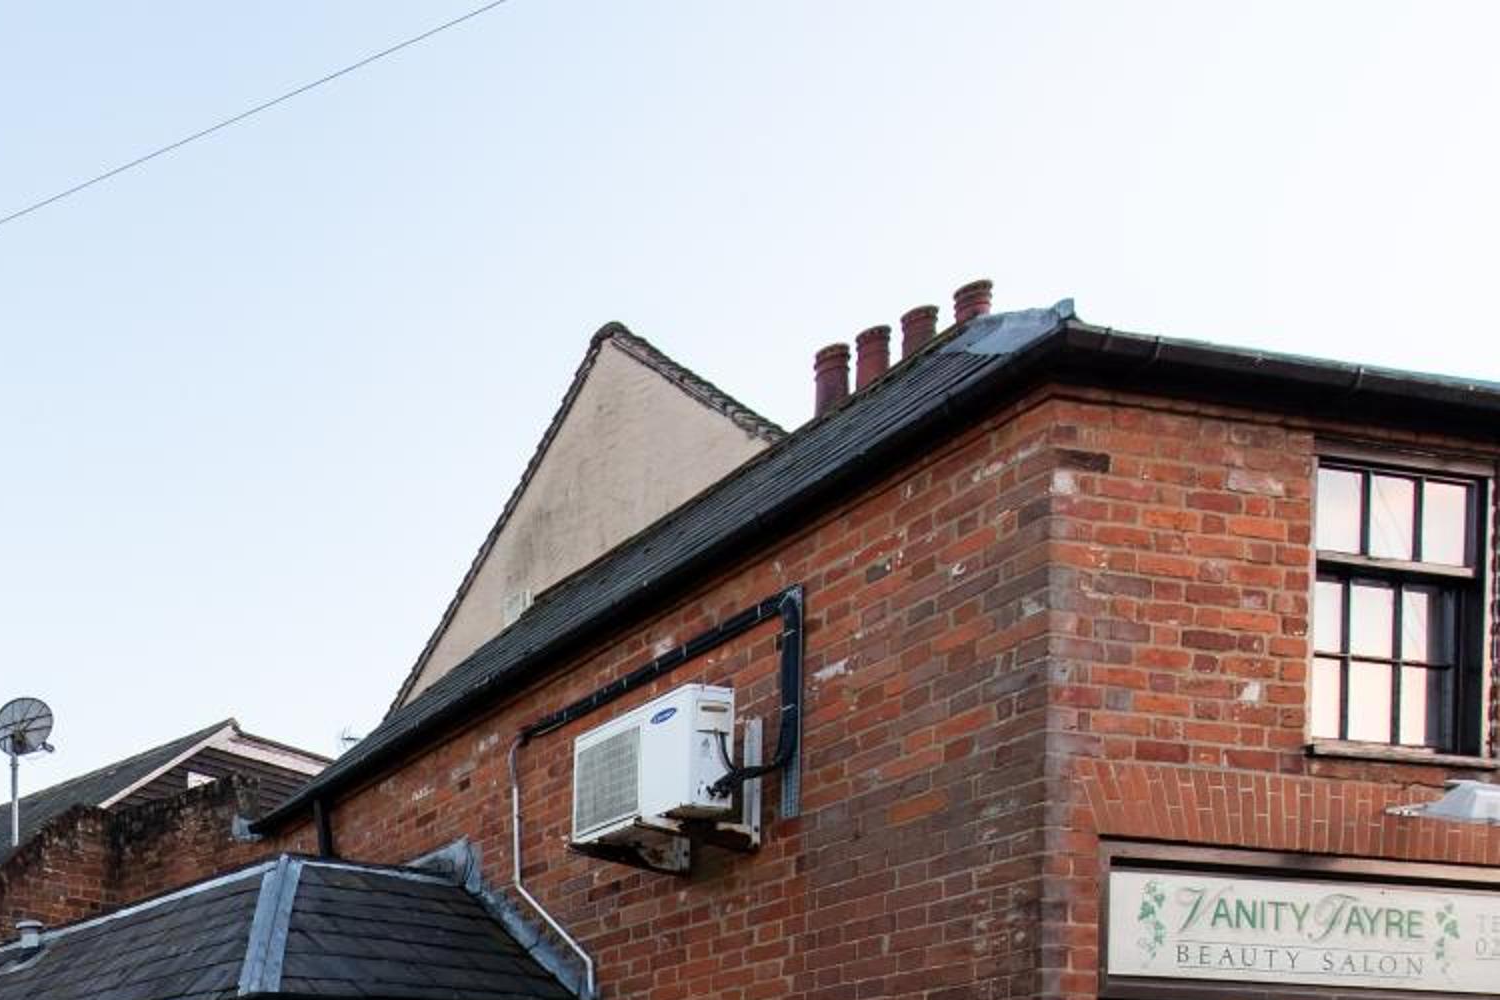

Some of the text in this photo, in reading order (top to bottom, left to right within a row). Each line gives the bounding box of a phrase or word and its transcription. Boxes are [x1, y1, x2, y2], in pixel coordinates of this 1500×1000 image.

[1172, 885, 1426, 942] VANITY FAYRE
[1176, 944, 1426, 977] BEAUTY SALON
